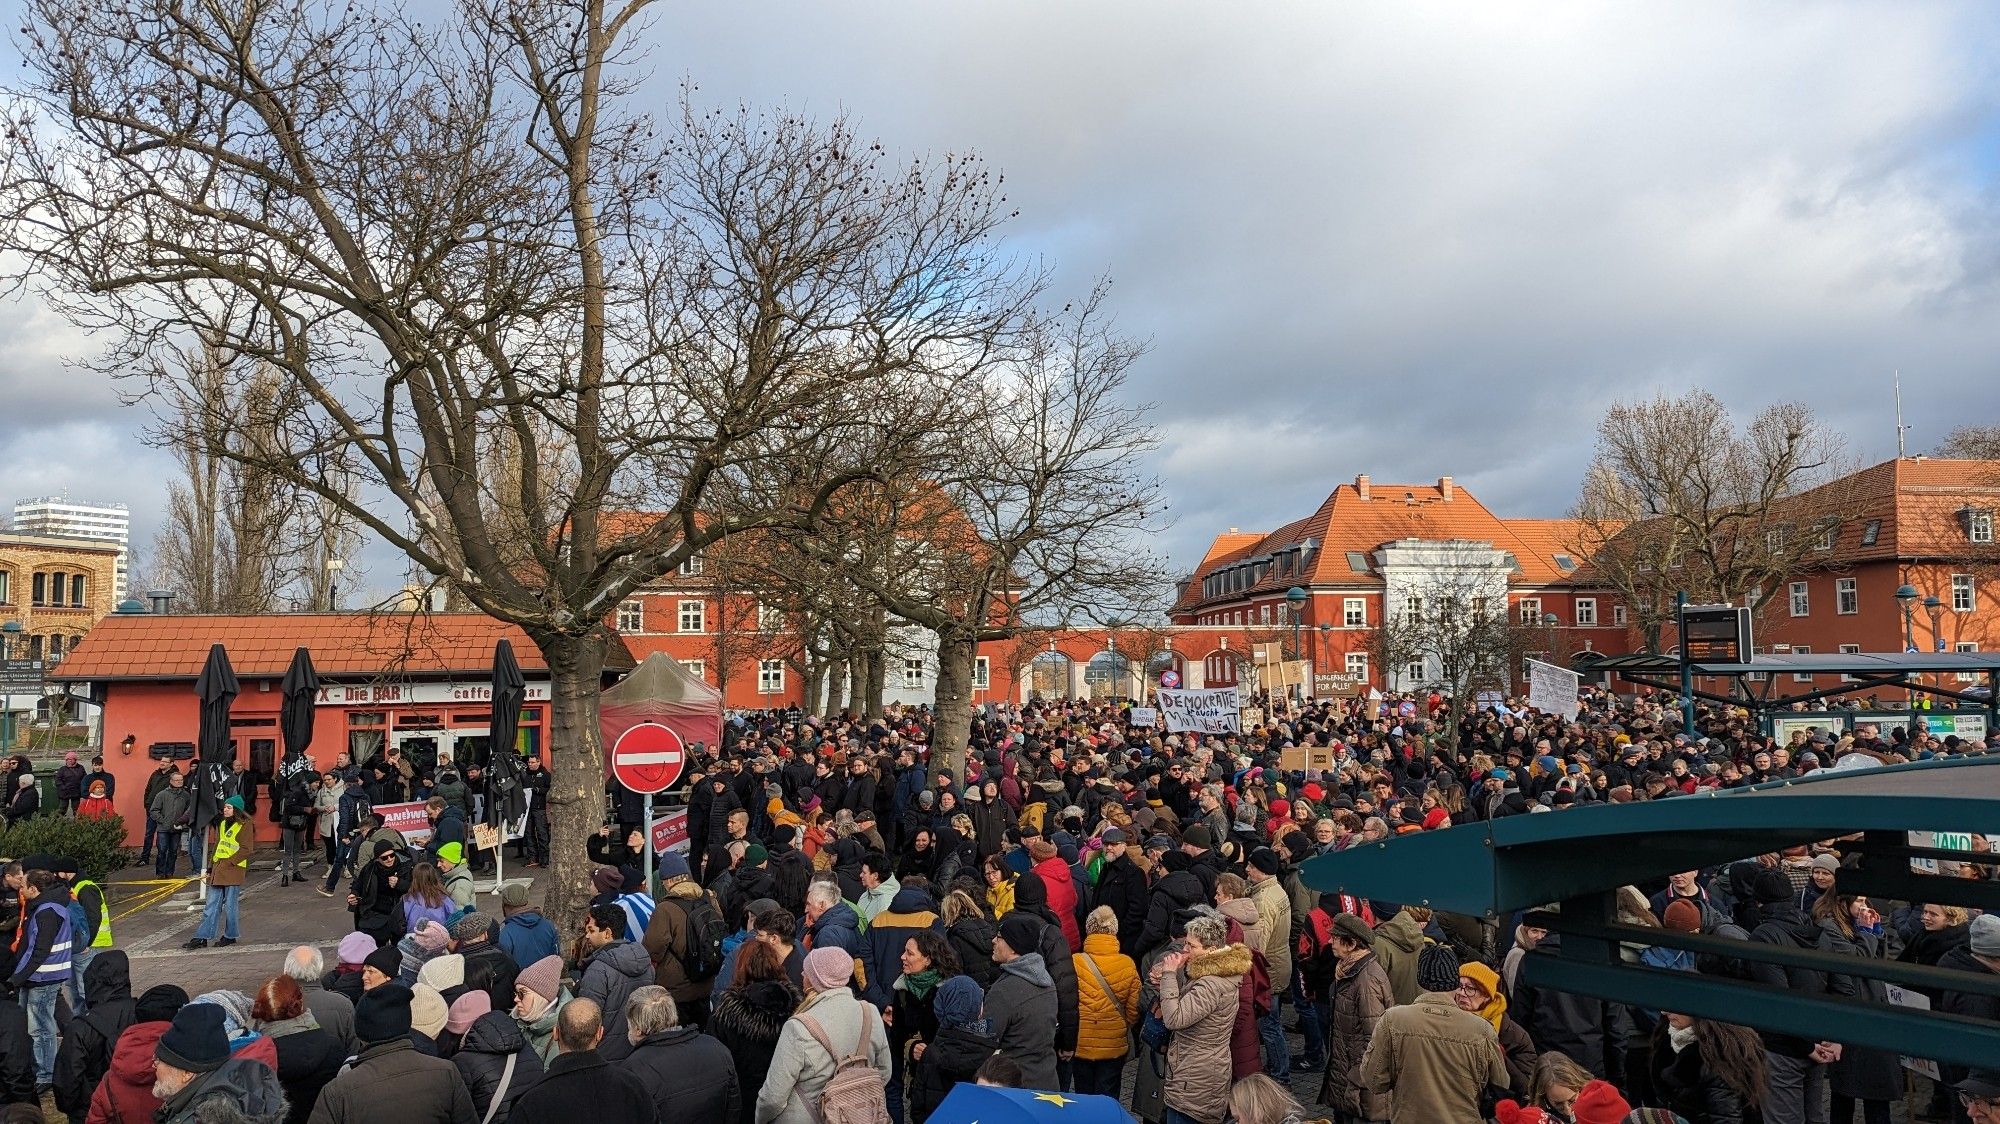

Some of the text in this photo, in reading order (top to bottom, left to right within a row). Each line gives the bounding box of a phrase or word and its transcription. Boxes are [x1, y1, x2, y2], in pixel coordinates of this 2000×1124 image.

[345, 687, 369, 701] Die
[373, 686, 401, 701] BAR
[454, 687, 490, 699] coffe
[1162, 691, 1236, 710] DEMOKRATIE
[656, 825, 677, 839] DAS
